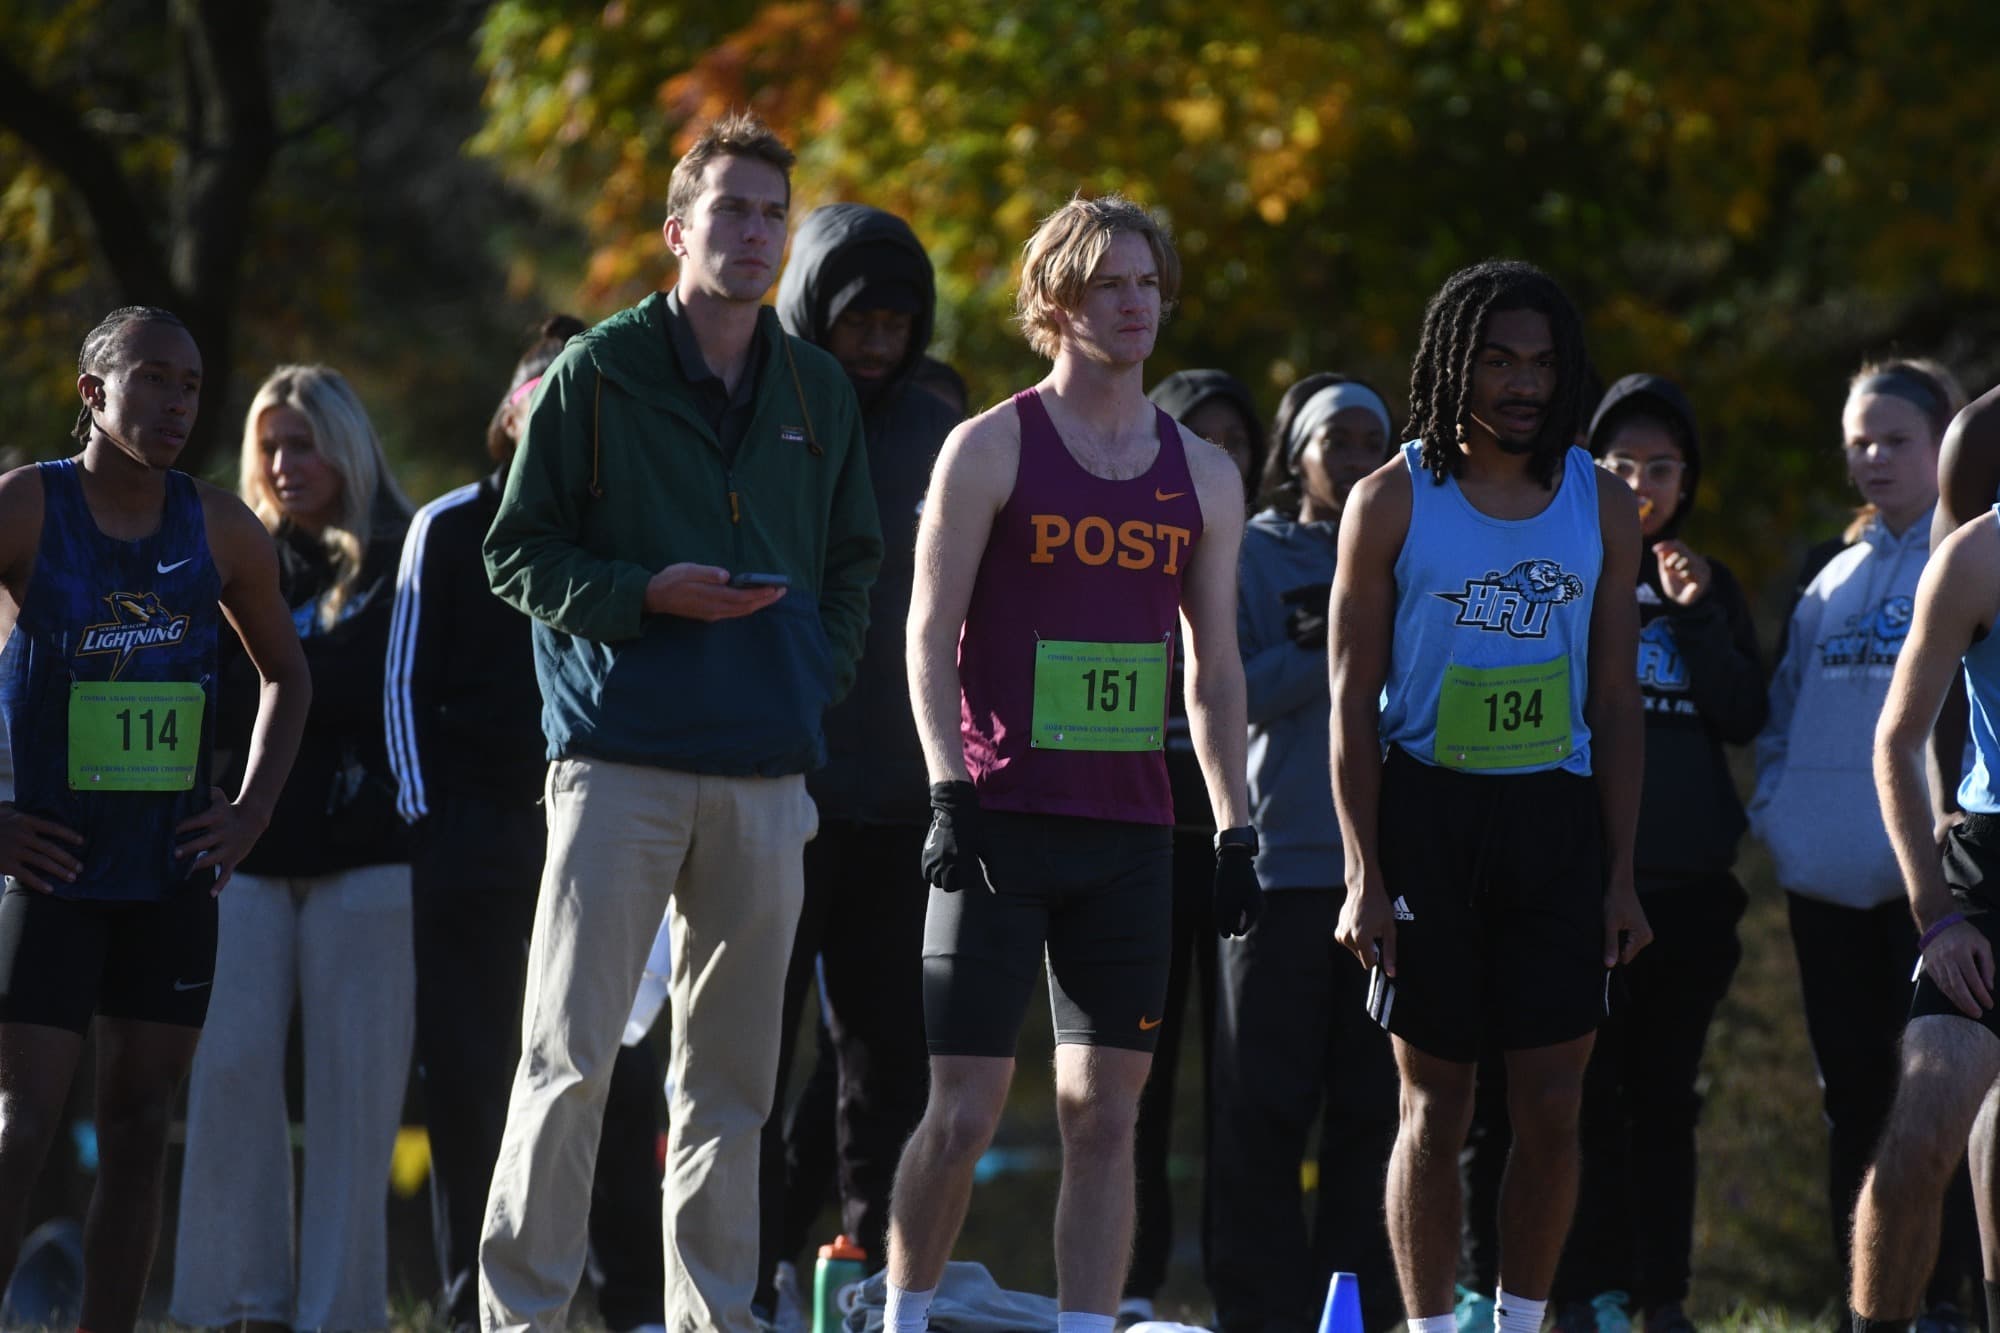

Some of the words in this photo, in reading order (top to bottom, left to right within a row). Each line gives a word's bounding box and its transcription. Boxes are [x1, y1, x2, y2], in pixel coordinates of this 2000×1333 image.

[1030, 514, 1191, 576] POST
[1457, 581, 1550, 637] HFU
[83, 620, 184, 656] LIGHTNING
[1082, 669, 1138, 711] 151
[1484, 688, 1544, 732] 134
[116, 708, 179, 751] 114
